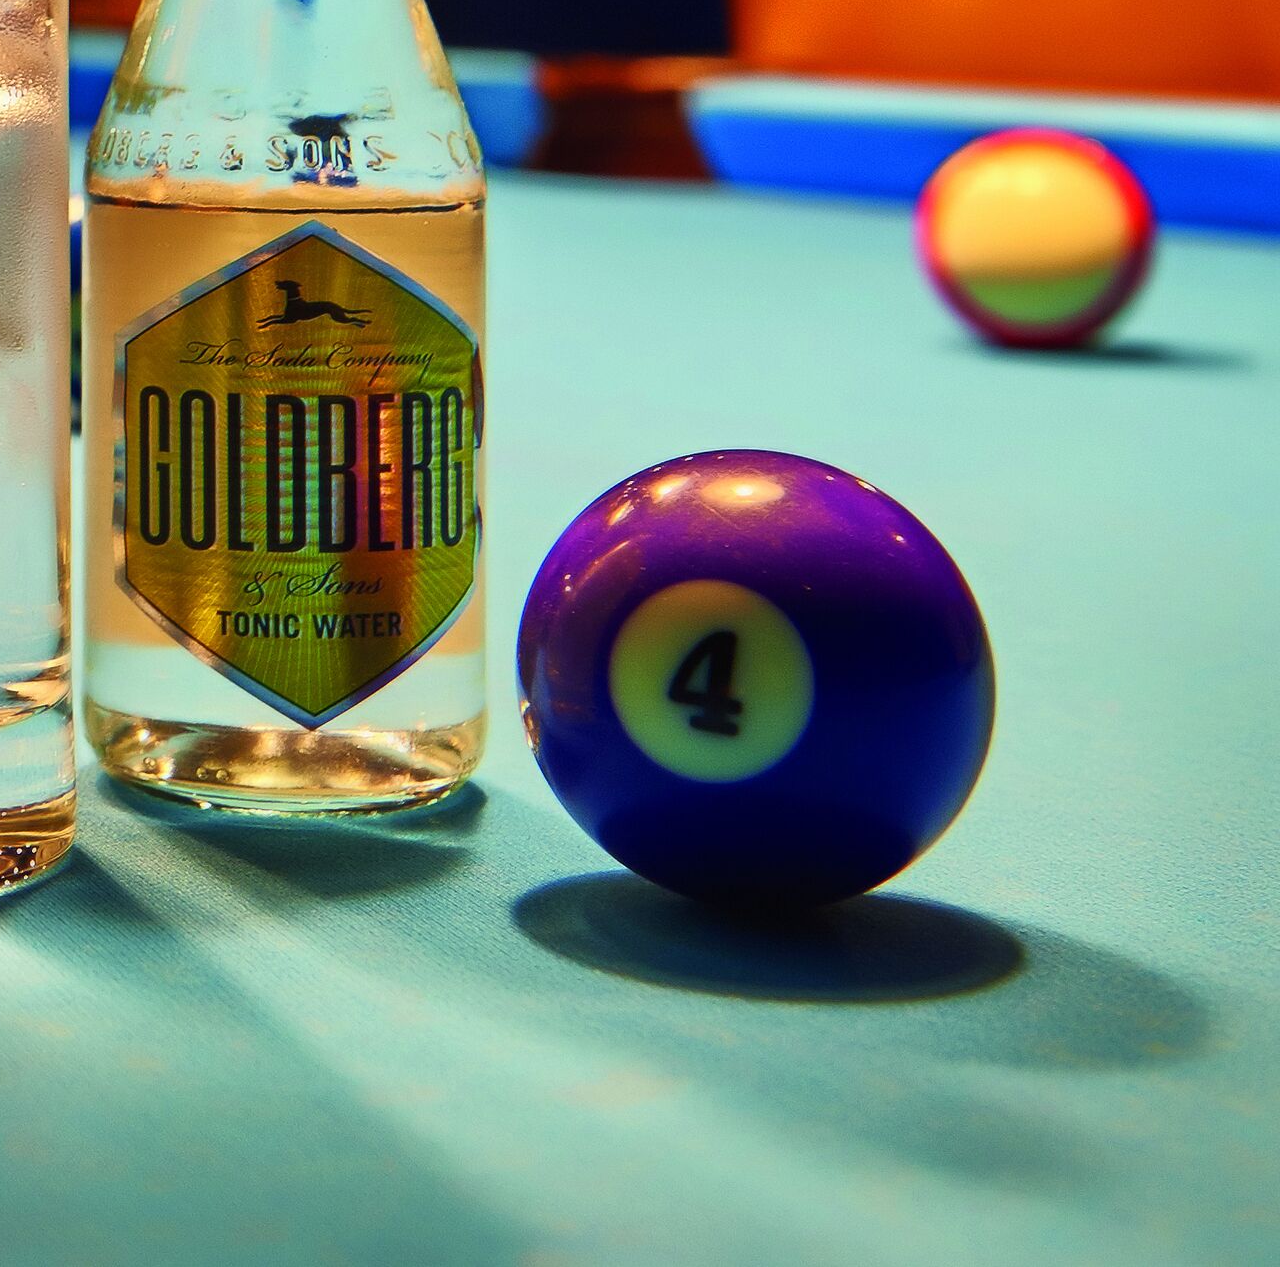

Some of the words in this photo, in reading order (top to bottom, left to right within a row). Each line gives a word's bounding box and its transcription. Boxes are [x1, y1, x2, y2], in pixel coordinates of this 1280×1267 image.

[265, 133, 397, 173] SONS
[180, 339, 237, 368] The
[242, 341, 317, 372] Soda
[324, 341, 436, 385] Company
[138, 384, 465, 554] GOLDBERG
[243, 570, 282, 607] &
[285, 561, 385, 600] Sons
[216, 610, 301, 640] TONIC
[313, 611, 403, 640] WATER
[667, 630, 745, 738] 4
